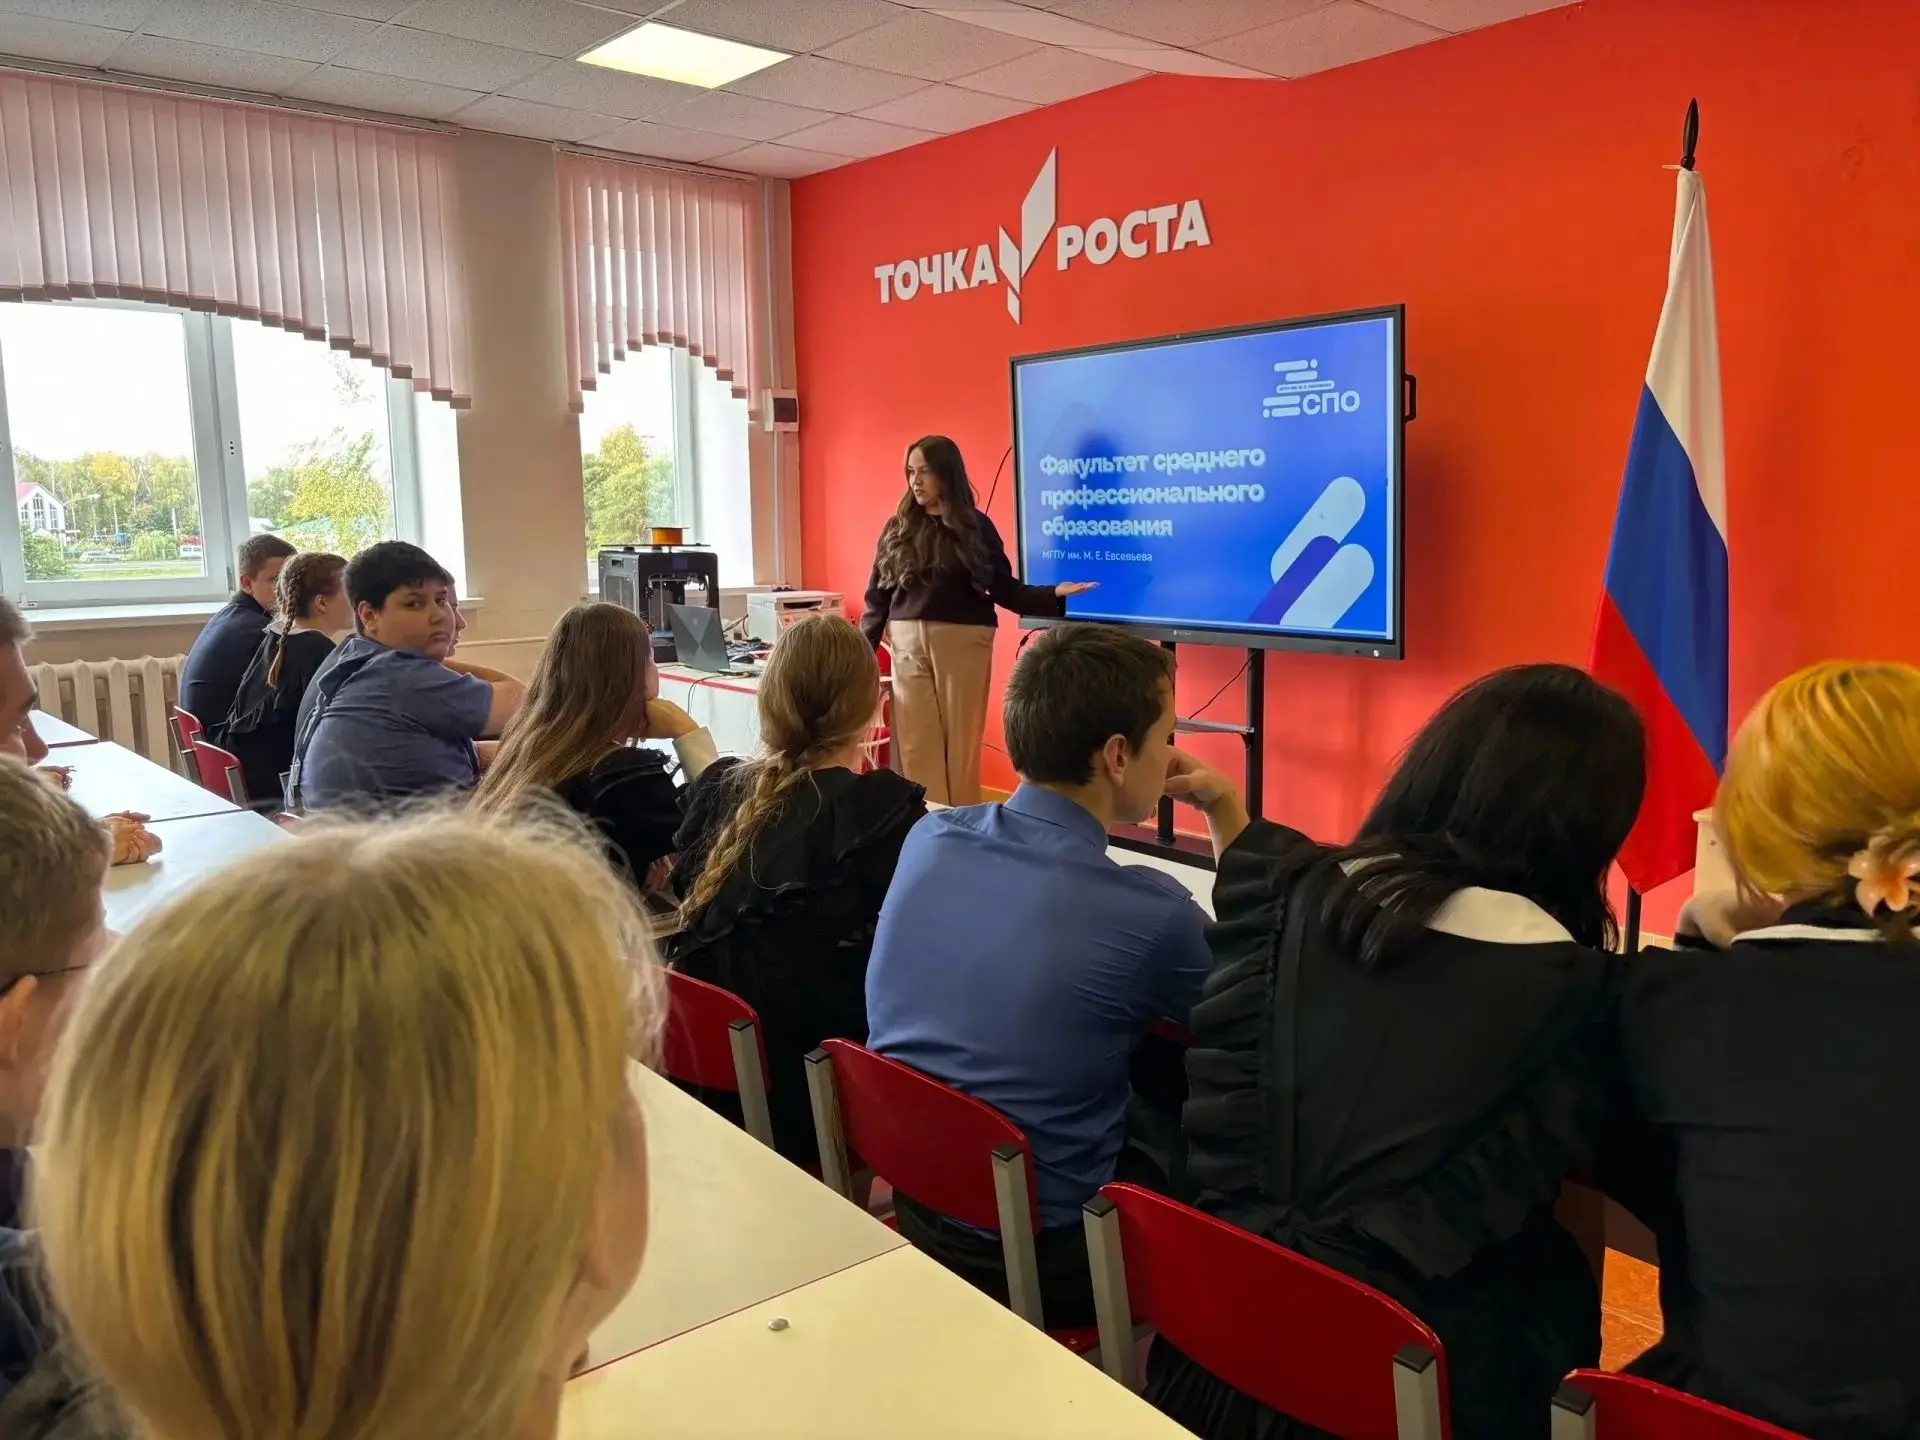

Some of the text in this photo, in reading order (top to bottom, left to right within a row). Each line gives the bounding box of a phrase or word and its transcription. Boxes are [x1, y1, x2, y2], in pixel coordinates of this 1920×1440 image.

[874, 199, 1211, 304] ТОЧКА РОСТА
[1302, 390, 1360, 415] СПО
[1039, 448, 1266, 479] Факультет среднего
[1040, 483, 1265, 510] профессионального
[1041, 516, 1173, 540] образования
[1042, 549, 1153, 562] МГПУ им. М. Е. Евсевьева
